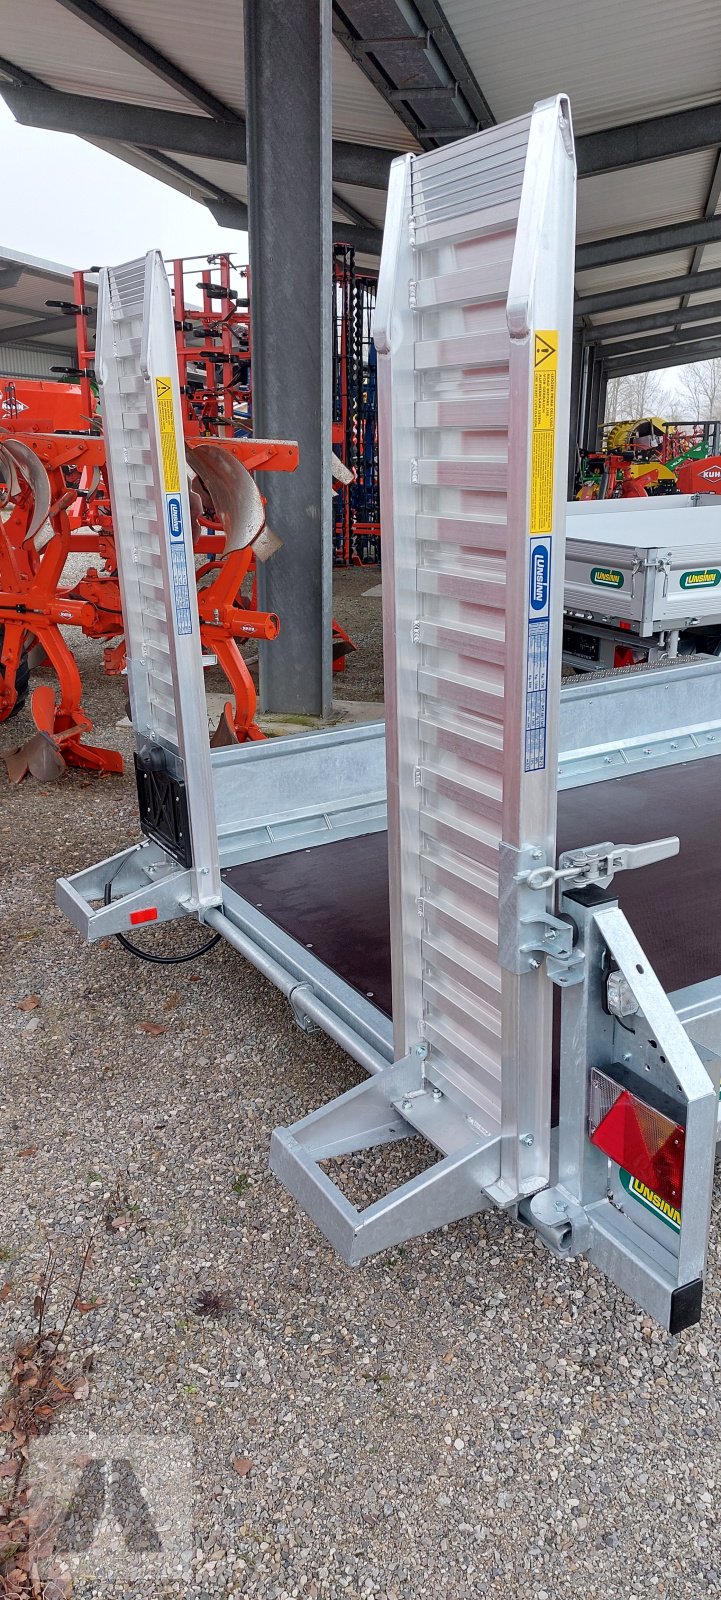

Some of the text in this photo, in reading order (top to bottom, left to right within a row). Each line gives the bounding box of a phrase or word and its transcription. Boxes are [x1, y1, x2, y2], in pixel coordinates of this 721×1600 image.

[536, 558, 548, 601] UNSINN
[596, 570, 620, 582] UNSINN
[688, 570, 716, 583] UNSINN
